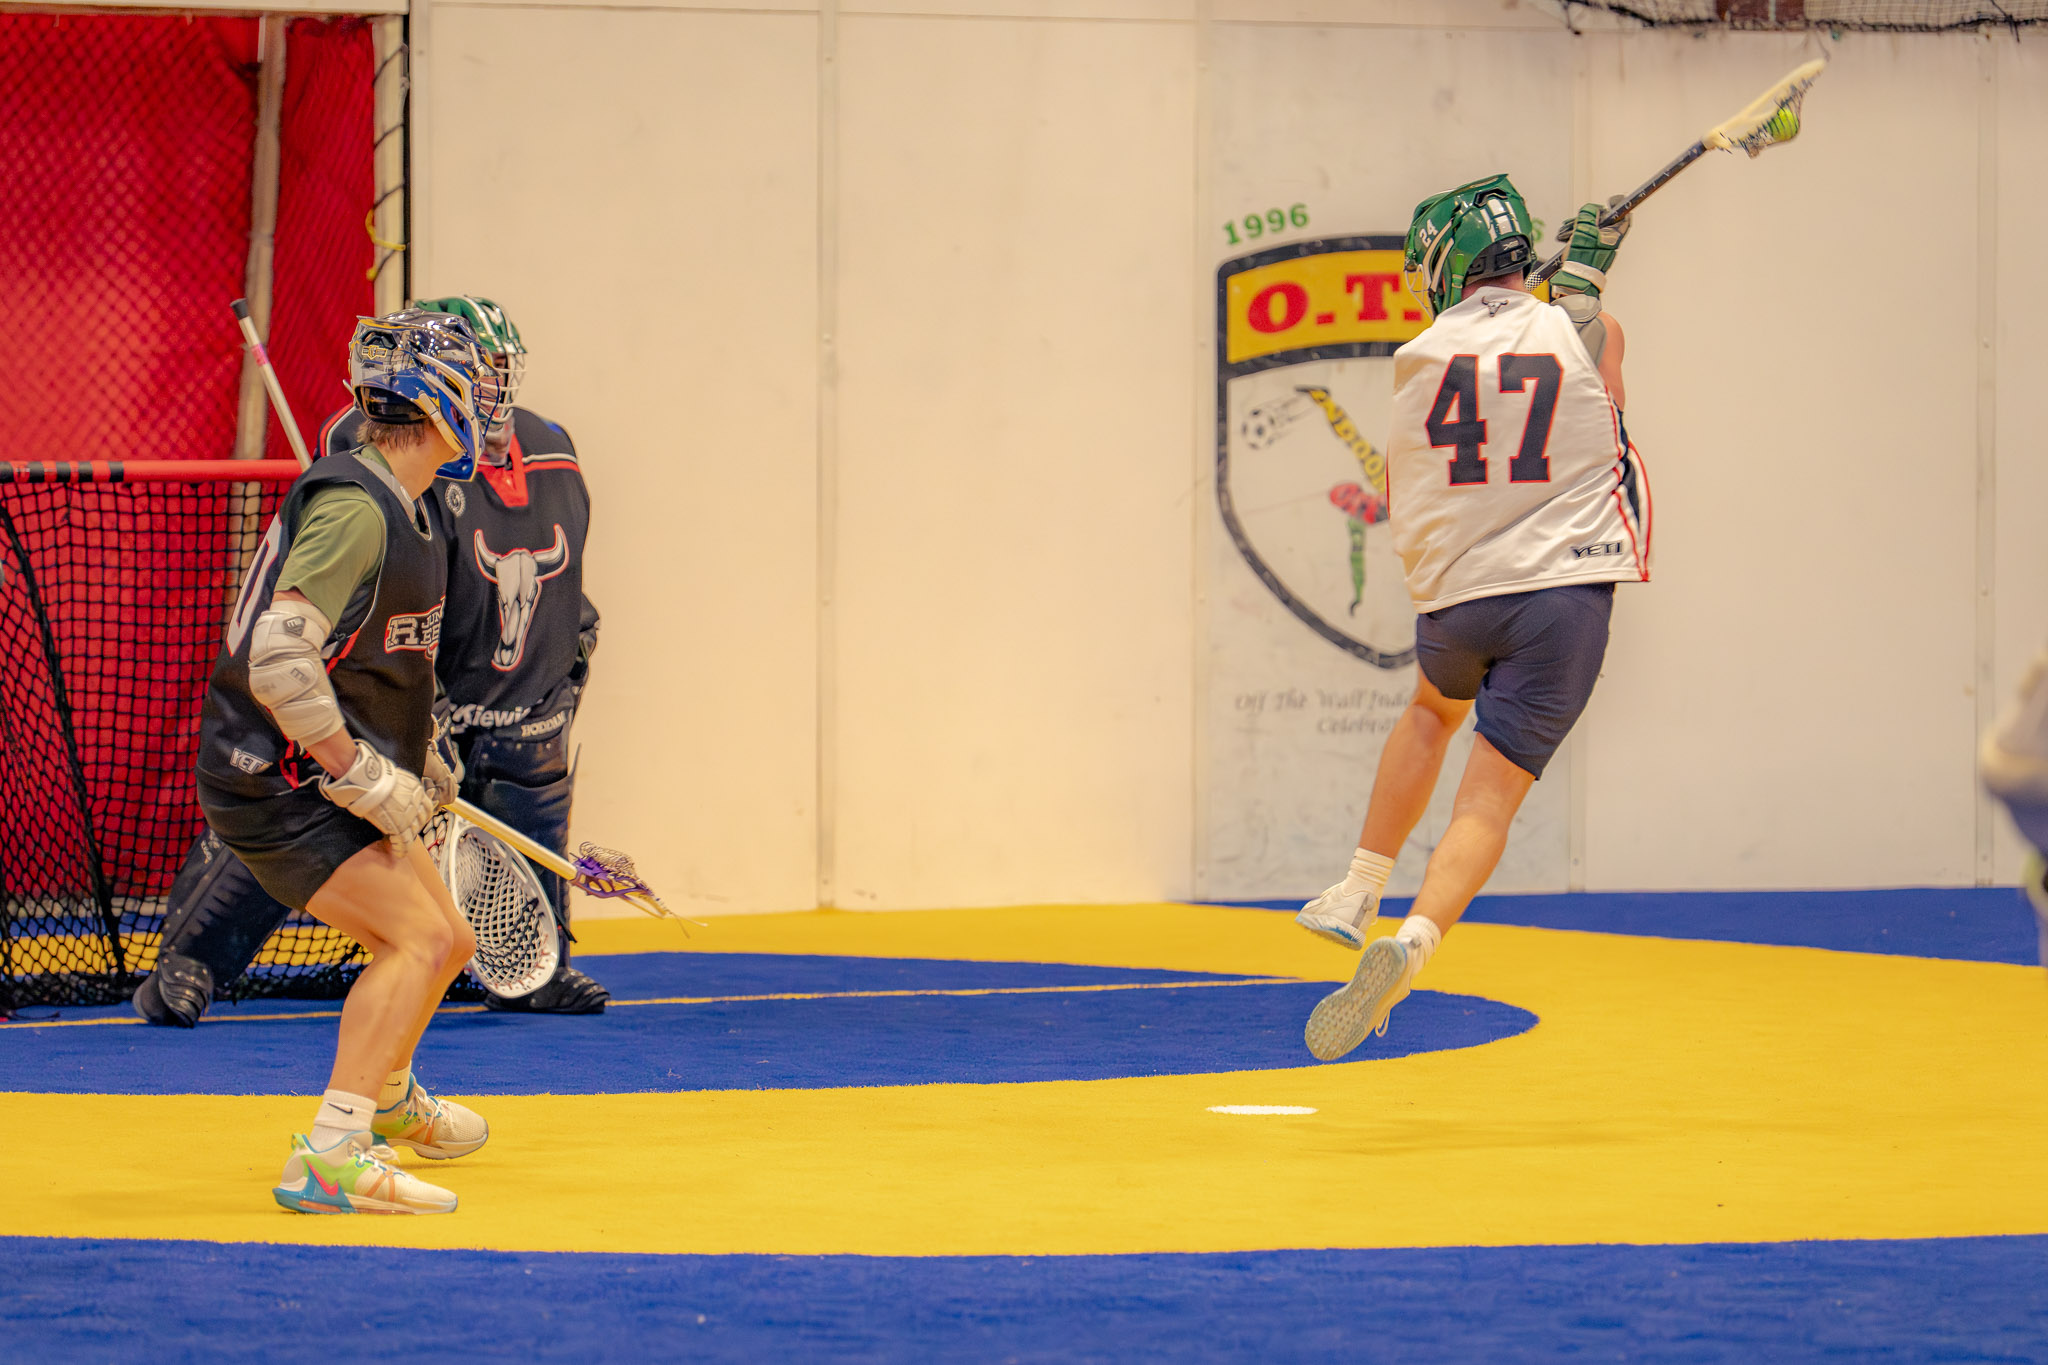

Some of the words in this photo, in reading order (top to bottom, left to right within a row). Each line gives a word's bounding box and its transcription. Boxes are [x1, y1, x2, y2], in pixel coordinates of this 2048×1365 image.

[1223, 202, 1310, 245] 1996
[1419, 219, 1439, 248] 24
[1424, 352, 1564, 486] 47
[1571, 540, 1623, 560] YETI
[230, 747, 268, 775] YET
